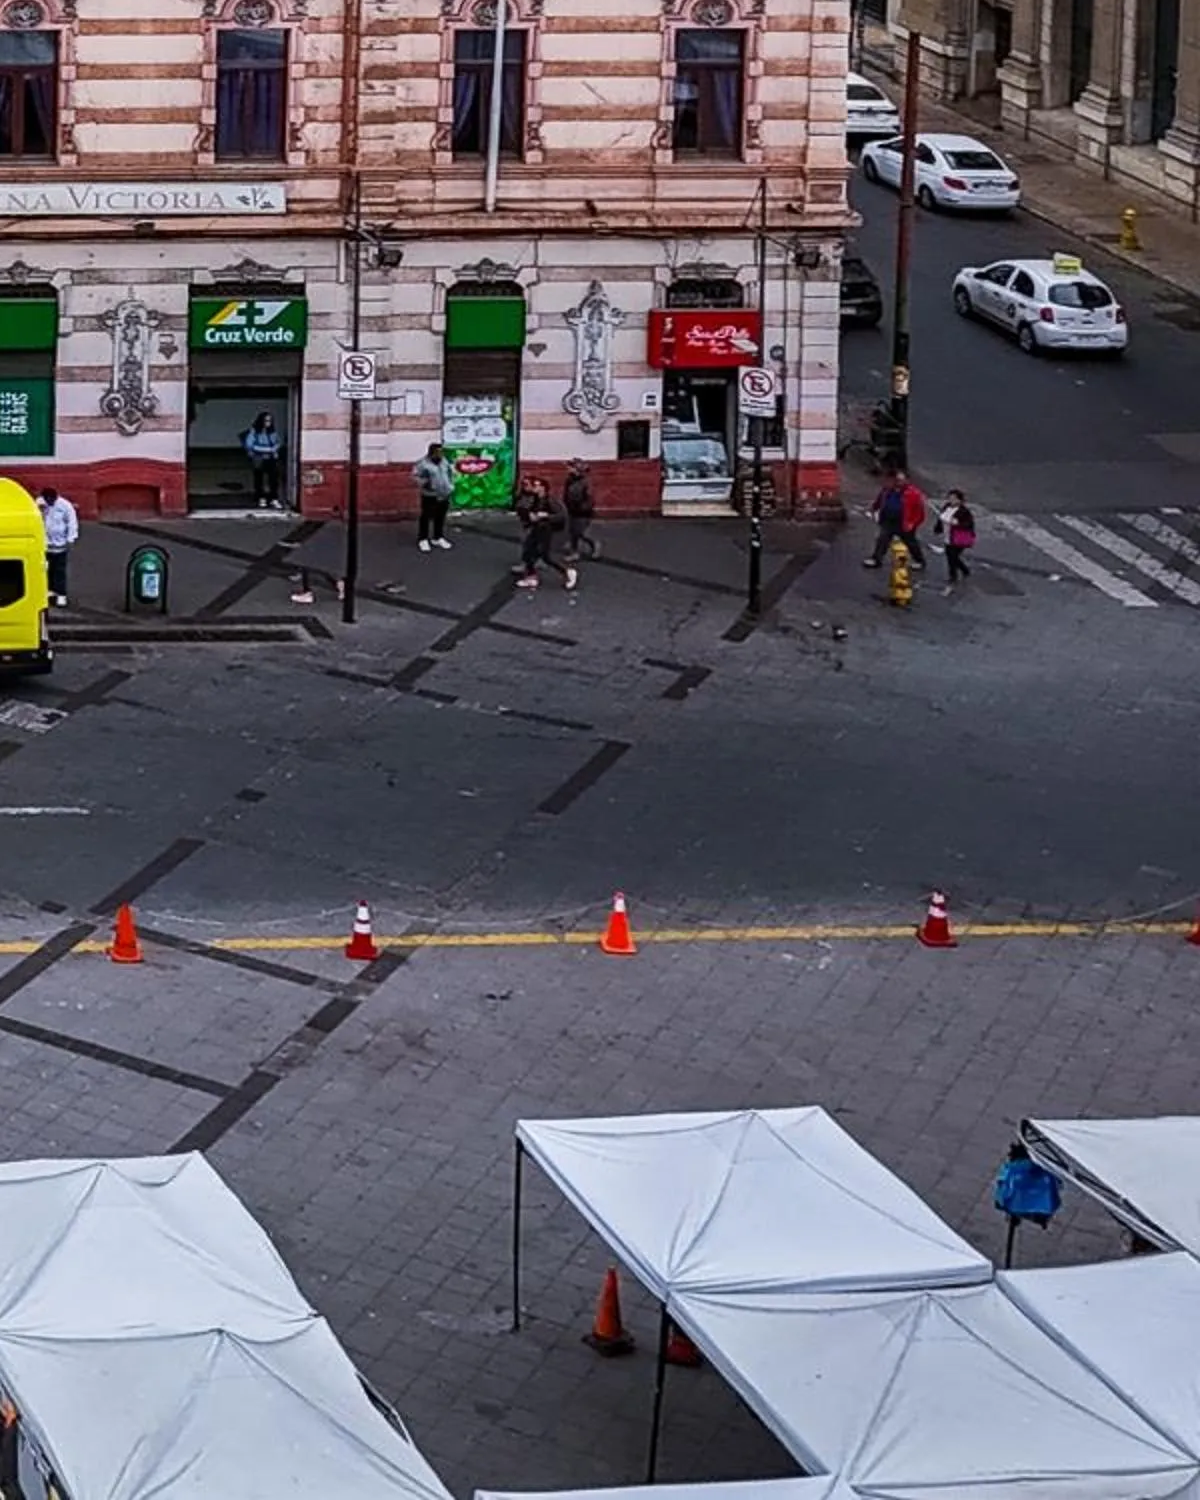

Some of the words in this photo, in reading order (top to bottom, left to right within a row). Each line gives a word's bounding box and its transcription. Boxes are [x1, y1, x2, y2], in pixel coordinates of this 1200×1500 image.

[66, 185, 226, 211] VICTORIA
[204, 327, 242, 343] Cruz
[243, 326, 295, 343] Verde
